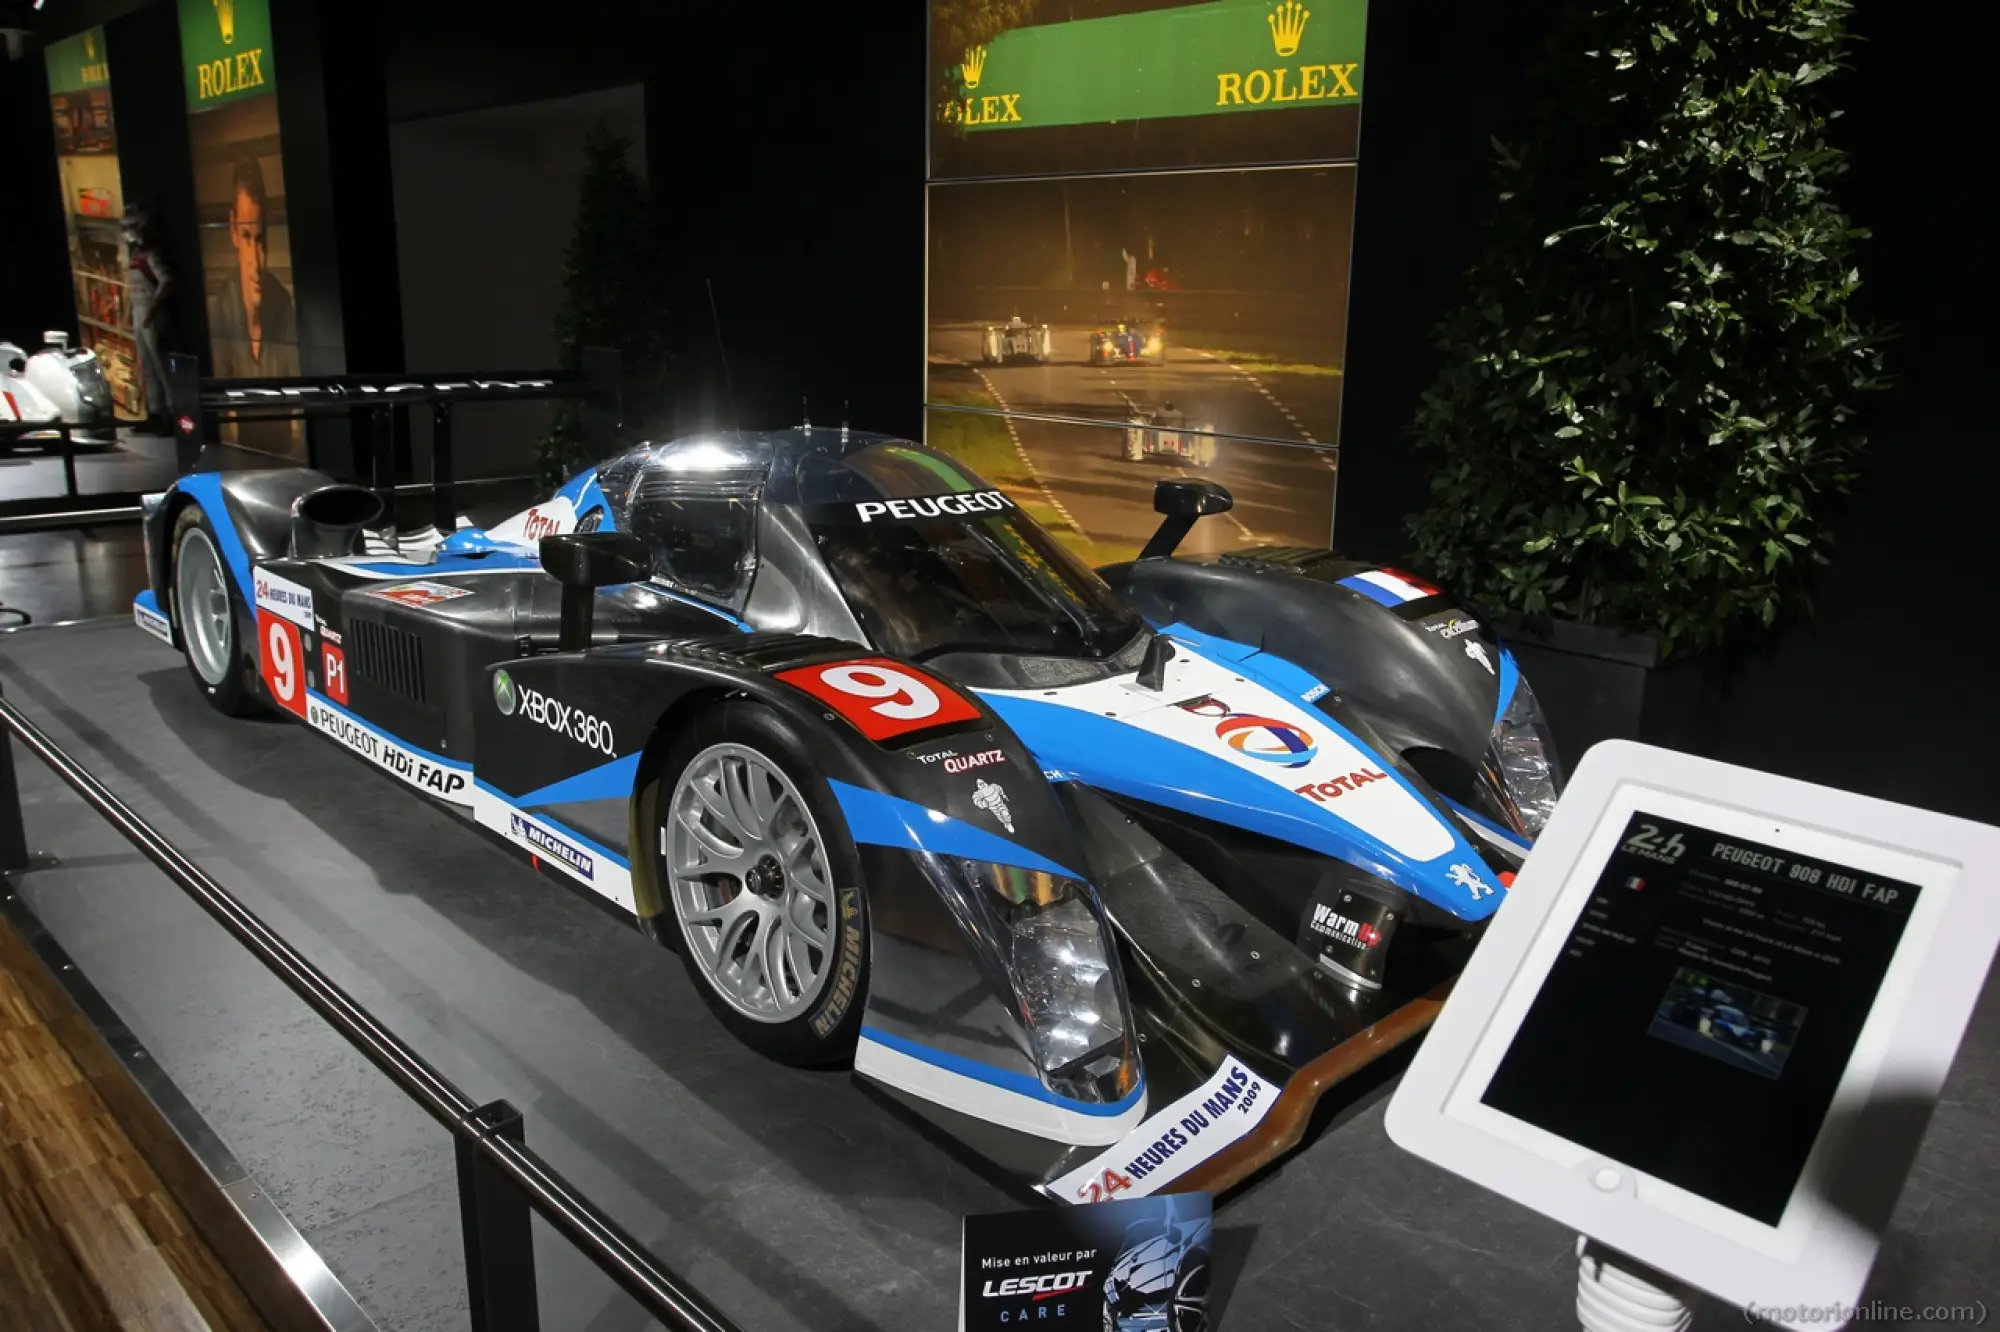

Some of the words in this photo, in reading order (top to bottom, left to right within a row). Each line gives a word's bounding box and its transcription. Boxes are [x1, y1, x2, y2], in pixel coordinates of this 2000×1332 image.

[197, 48, 265, 99] ROLEX
[1215, 63, 1359, 107] ROLEX
[855, 491, 1015, 523] PEUGEOT
[269, 622, 295, 701] 9
[325, 652, 345, 694] P1
[820, 664, 941, 720] 9
[320, 708, 379, 759] PEUGEOT
[382, 745, 414, 777] HDi
[417, 763, 466, 794] FAP
[916, 749, 959, 765] TOTAL
[943, 749, 1006, 774] QUARTZ
[1294, 767, 1388, 802] TOTAL
[528, 826, 592, 873] MICHELIN
[1711, 842, 1786, 874] PEUGEOT
[1788, 863, 1822, 885] 908
[1826, 872, 1856, 895] HDI
[1861, 883, 1900, 904] FAP
[814, 925, 861, 1035] MICHELIN
[1237, 1081, 1263, 1115] 2009
[1124, 1127, 1189, 1180] HEURES
[1180, 1109, 1210, 1136] DU
[1202, 1066, 1249, 1119] MANS
[982, 1256, 1011, 1269] Mise
[1014, 1256, 1030, 1266] en
[1033, 1251, 1073, 1264] valeur
[1075, 1248, 1097, 1261] par
[982, 1270, 1093, 1297] LESCOT
[1000, 1303, 1066, 1322] CARE
